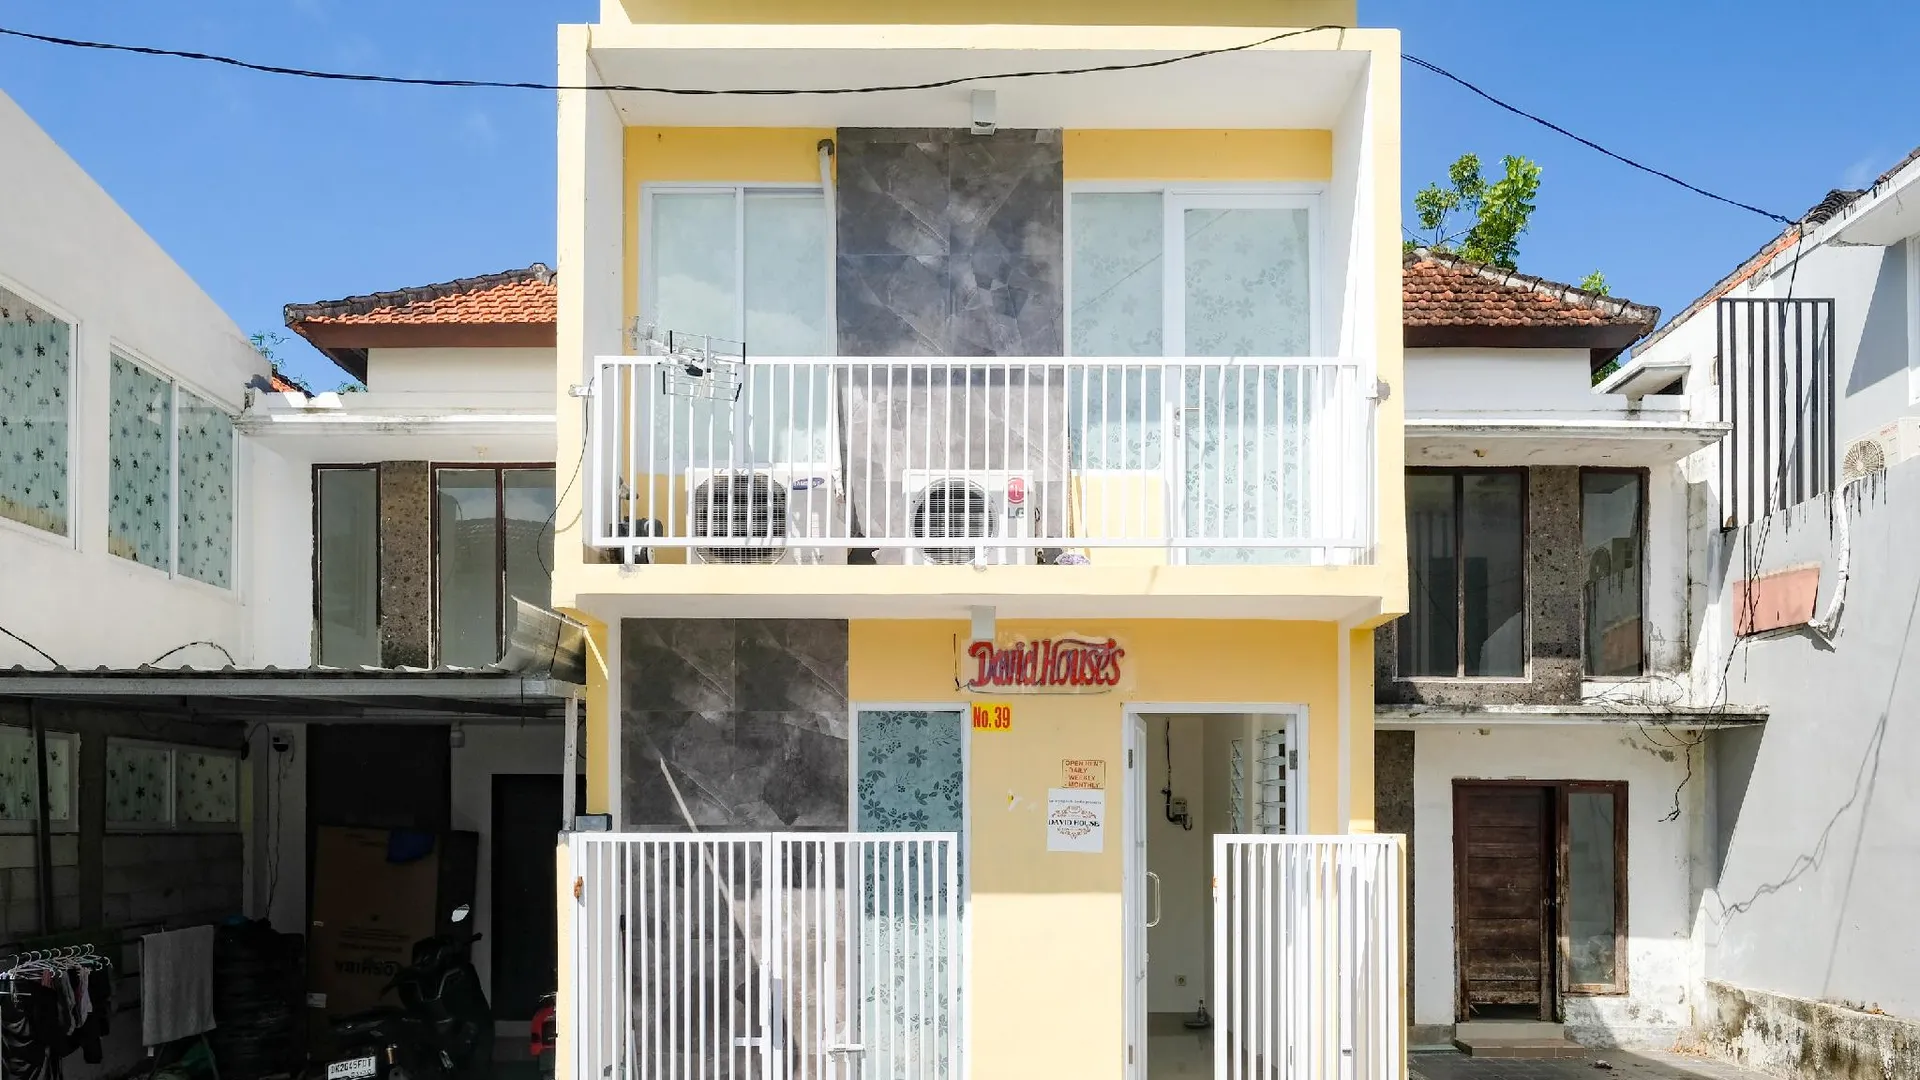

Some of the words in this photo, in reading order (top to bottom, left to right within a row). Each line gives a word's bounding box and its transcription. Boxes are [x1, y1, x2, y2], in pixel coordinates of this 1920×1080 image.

[1008, 507, 1025, 519] LG
[968, 639, 1040, 687] David
[973, 706, 992, 729] No.
[994, 706, 1011, 729] 39
[1068, 781, 1101, 789] MONTHLY
[1073, 819, 1100, 828] HOUSE
